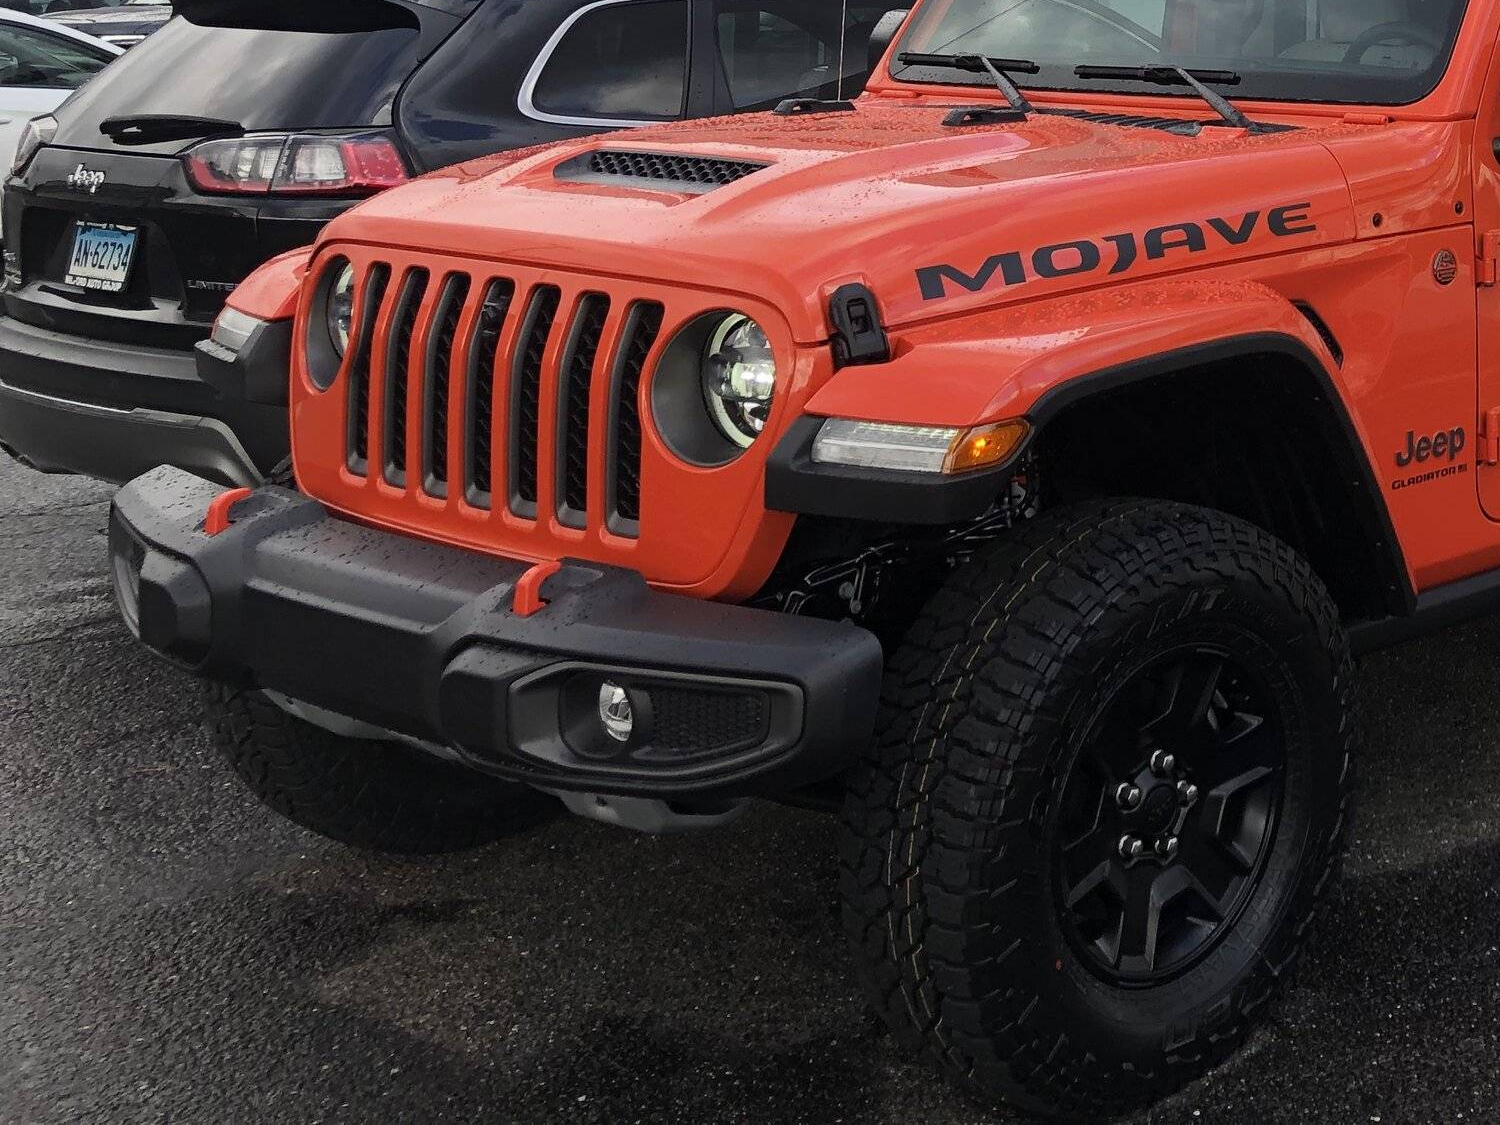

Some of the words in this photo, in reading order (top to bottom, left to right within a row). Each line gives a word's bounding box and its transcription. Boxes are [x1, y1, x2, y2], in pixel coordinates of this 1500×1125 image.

[67, 163, 105, 194] Jeep
[915, 201, 1317, 301] MOJAVE
[1395, 427, 1466, 468] Jeep
[1391, 466, 1457, 491] GLADIATOR
